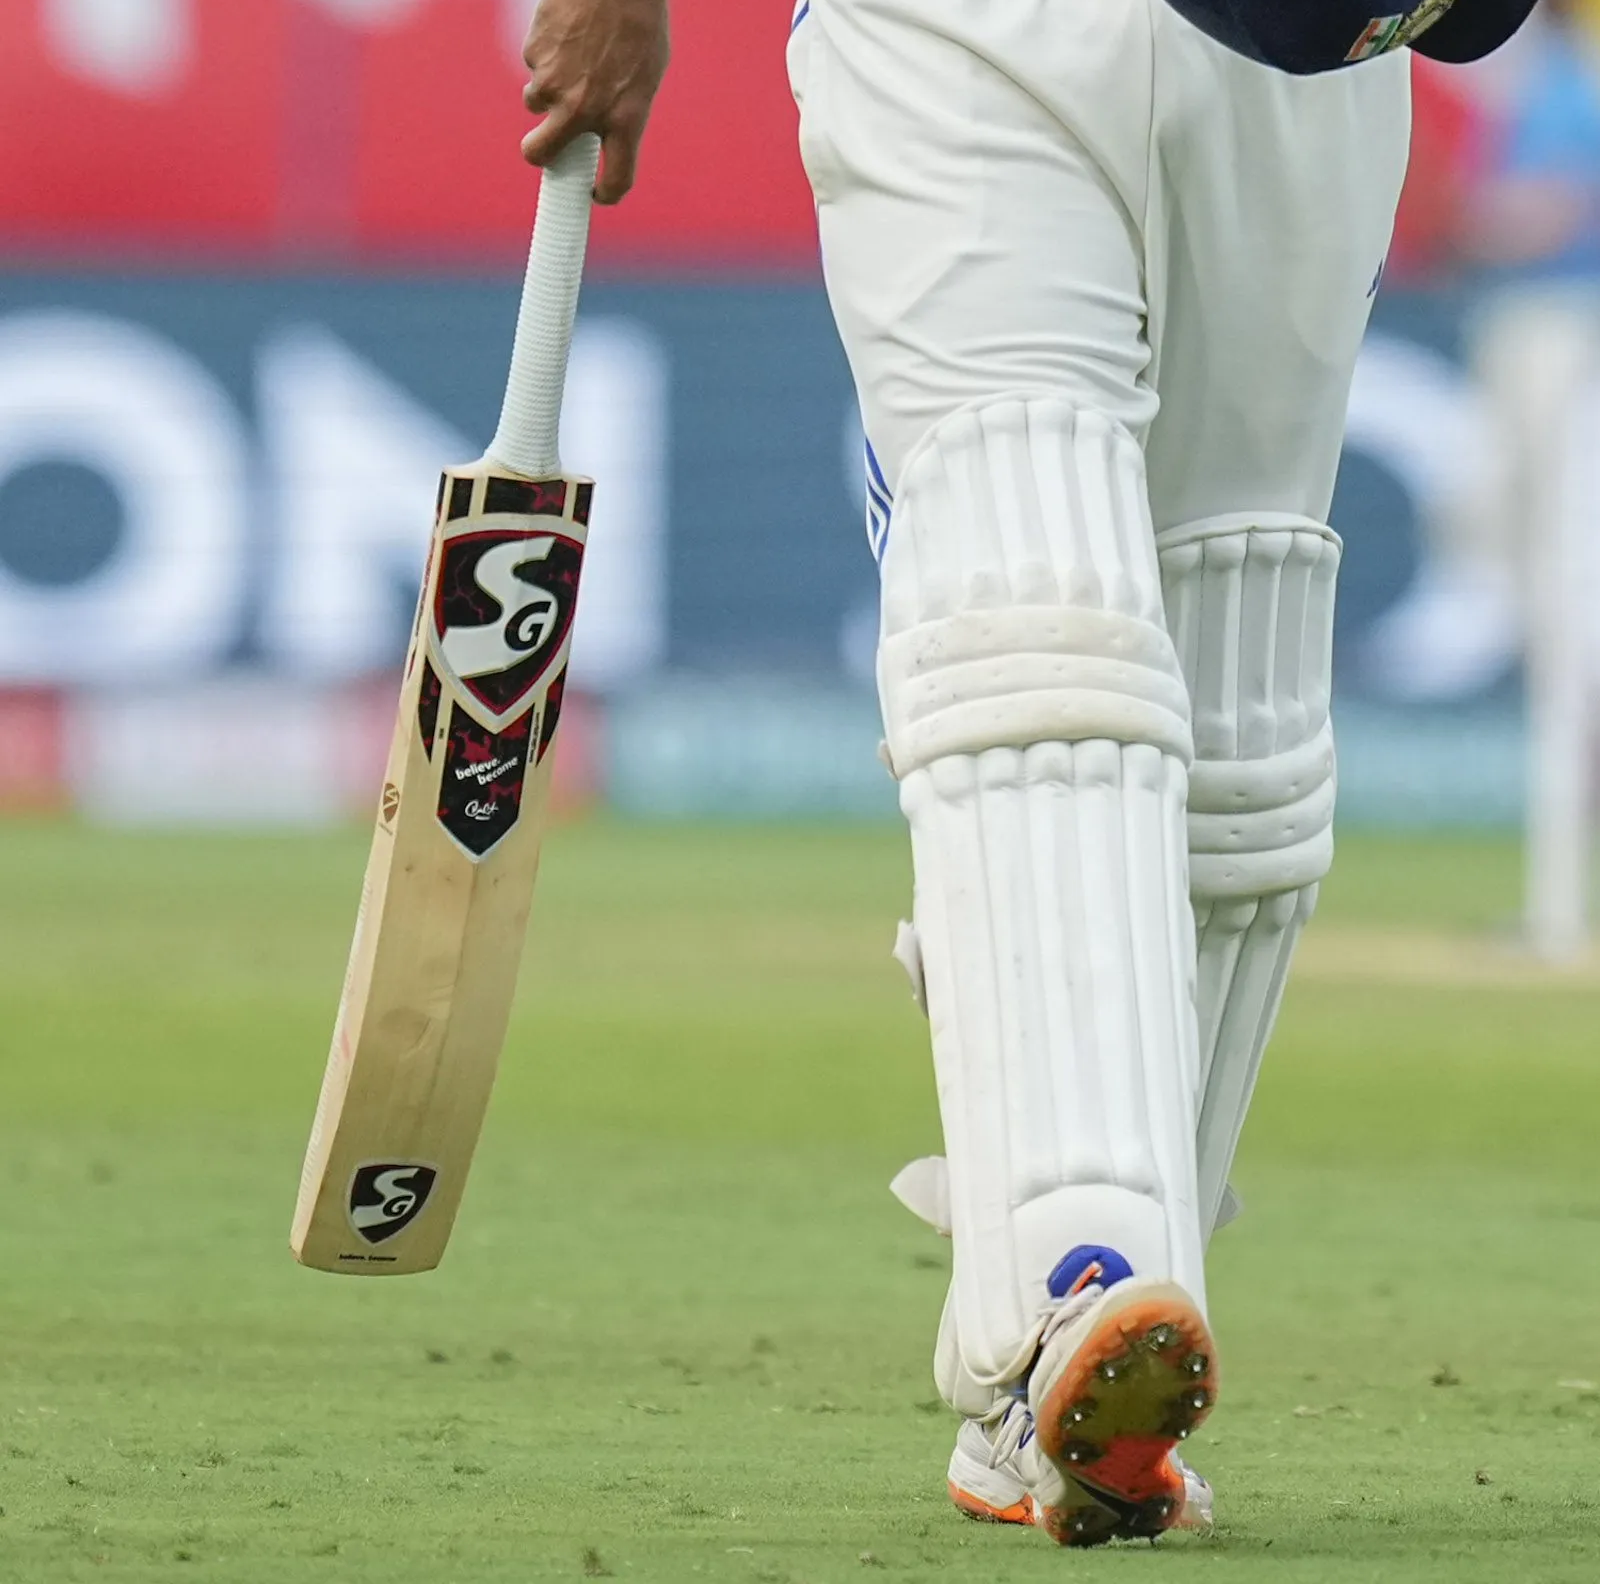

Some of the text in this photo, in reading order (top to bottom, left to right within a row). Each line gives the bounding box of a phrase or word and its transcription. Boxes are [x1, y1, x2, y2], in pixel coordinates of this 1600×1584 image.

[440, 536, 559, 679] SG
[477, 757, 518, 785] become
[352, 1167, 420, 1230] SG
